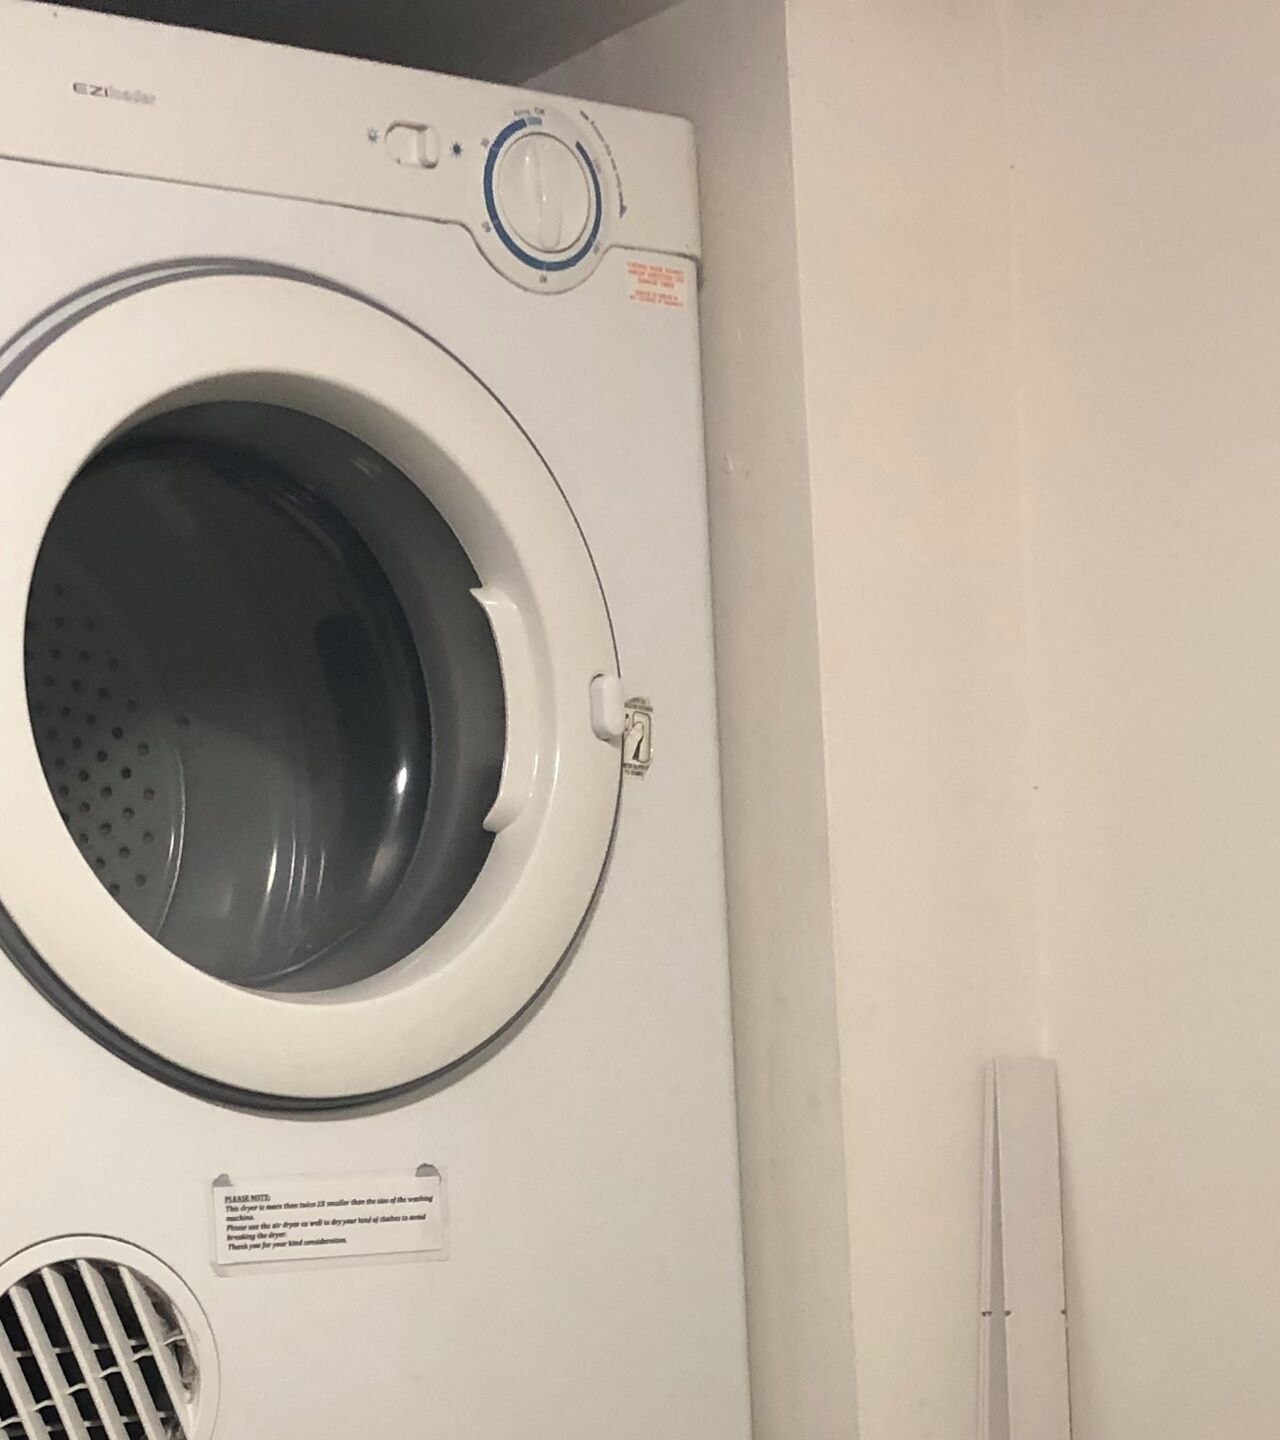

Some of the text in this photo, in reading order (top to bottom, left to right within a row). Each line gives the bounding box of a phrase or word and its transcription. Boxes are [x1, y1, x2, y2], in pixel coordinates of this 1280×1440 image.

[225, 1195, 249, 1204] PLEASE
[226, 1205, 239, 1213] This
[240, 1205, 258, 1213] dryer
[327, 1199, 350, 1208] smaller
[397, 1196, 406, 1204] the
[408, 1195, 433, 1204] washing
[283, 1222, 300, 1230] dryer
[227, 1233, 255, 1241] breaking
[257, 1231, 267, 1239] the
[228, 1242, 248, 1251] Thank
[248, 1243, 261, 1251] you
[261, 1240, 271, 1250] for
[272, 1241, 287, 1250] your
[288, 1239, 303, 1247] kind
